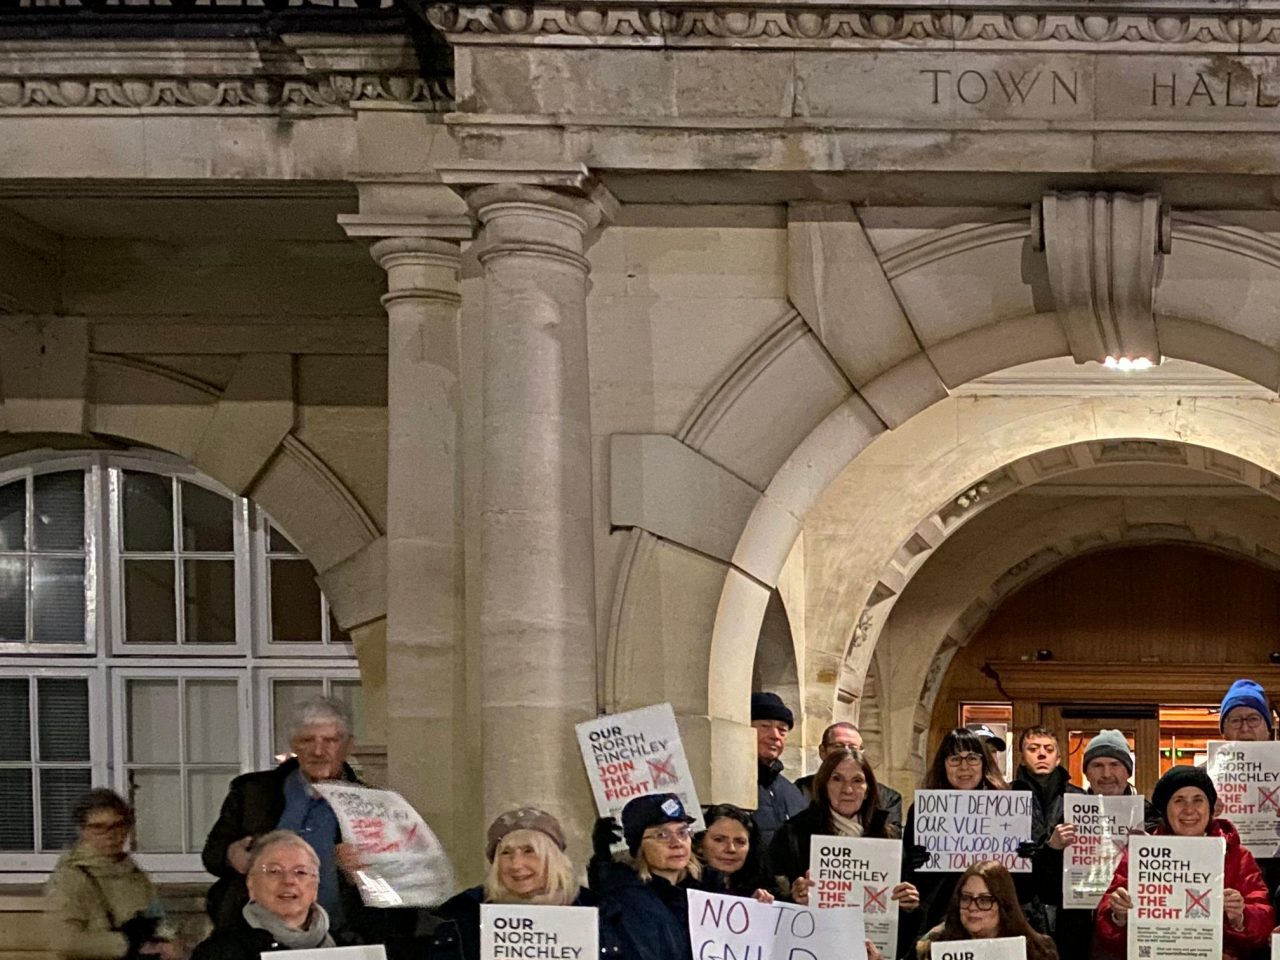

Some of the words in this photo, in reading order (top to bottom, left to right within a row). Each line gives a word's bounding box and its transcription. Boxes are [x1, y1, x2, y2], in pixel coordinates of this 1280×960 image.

[919, 69, 1079, 106] TOWN
[1150, 72, 1280, 109] HALL
[589, 726, 622, 742] OUR
[592, 733, 645, 753] NORTH
[595, 739, 669, 765] FINCHLEY
[598, 760, 634, 778] JOIN
[600, 774, 632, 790] THE
[1217, 772, 1280, 782] FINCHLEY
[604, 781, 650, 801] FIGHT
[918, 794, 962, 815] DON'T
[968, 795, 1032, 817] DEMOLISH
[1072, 804, 1100, 814] OUR
[916, 815, 949, 834] OUR
[953, 816, 991, 835] VUE
[1071, 835, 1102, 845] JOIN
[820, 846, 852, 857] OUR
[1072, 846, 1097, 855] THE
[1138, 847, 1171, 858] OUR
[819, 858, 869, 870] NORTH
[1138, 860, 1191, 871] NORTH
[819, 869, 888, 882] FINCHLEY
[1138, 871, 1211, 883] FINCHLEY
[818, 880, 852, 892] JOIN
[1137, 884, 1173, 895] JOIN
[818, 892, 846, 902] THE
[1137, 896, 1167, 907] THE
[701, 899, 750, 934] NO
[773, 906, 815, 938] TO
[1137, 908, 1182, 919] FIGHT
[493, 918, 533, 930] OUR
[494, 932, 558, 944] NORTH
[494, 946, 582, 959] FINCHLEY
